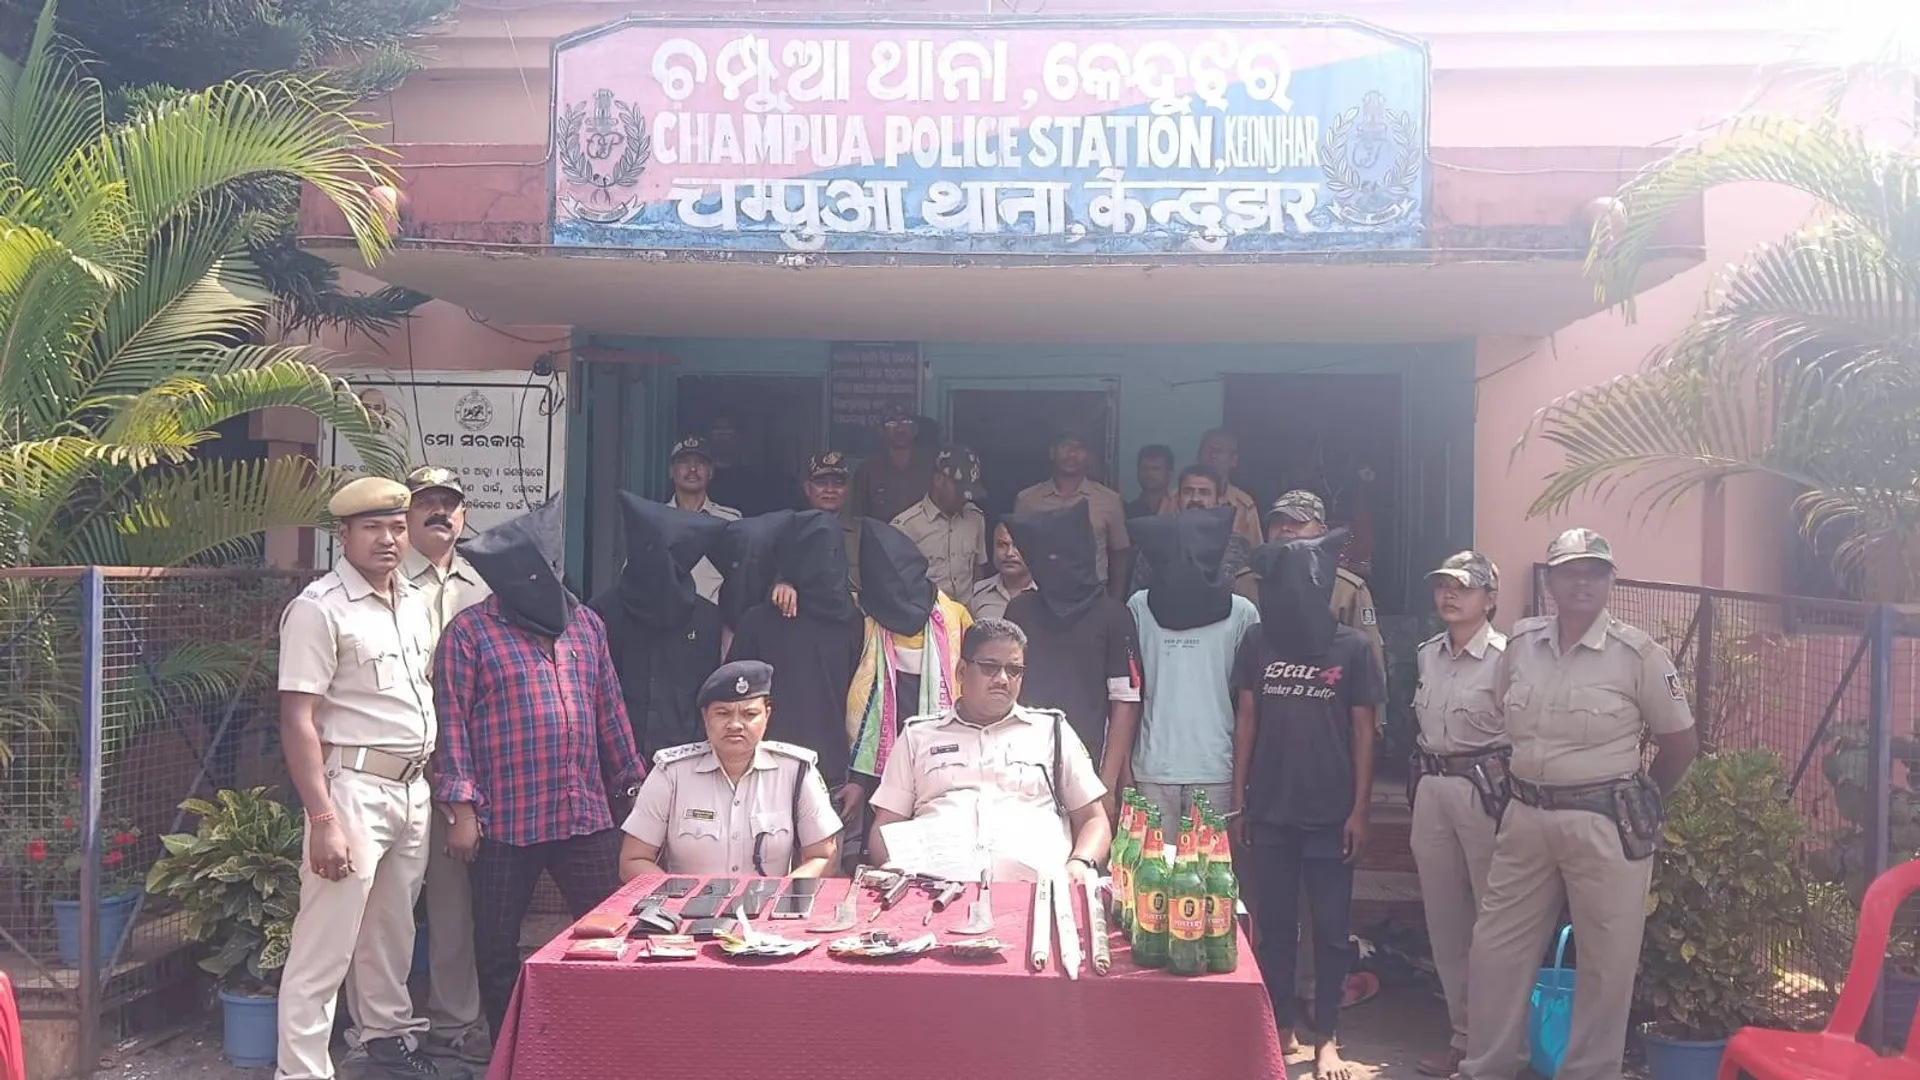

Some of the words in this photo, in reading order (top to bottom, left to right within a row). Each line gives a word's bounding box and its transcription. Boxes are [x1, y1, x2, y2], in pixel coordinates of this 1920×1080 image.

[651, 32, 851, 113] ଚମ୍ପୁଆ
[867, 39, 1008, 102] ଥାନା
[652, 111, 875, 167] CHAMPUA
[884, 115, 1021, 169] POLICE
[667, 177, 909, 250] चम्पुआ
[424, 434, 454, 447] ମୋ
[460, 434, 526, 448] ସରକାର
[1264, 660, 1320, 680] Gear
[1320, 665, 1343, 685] 4
